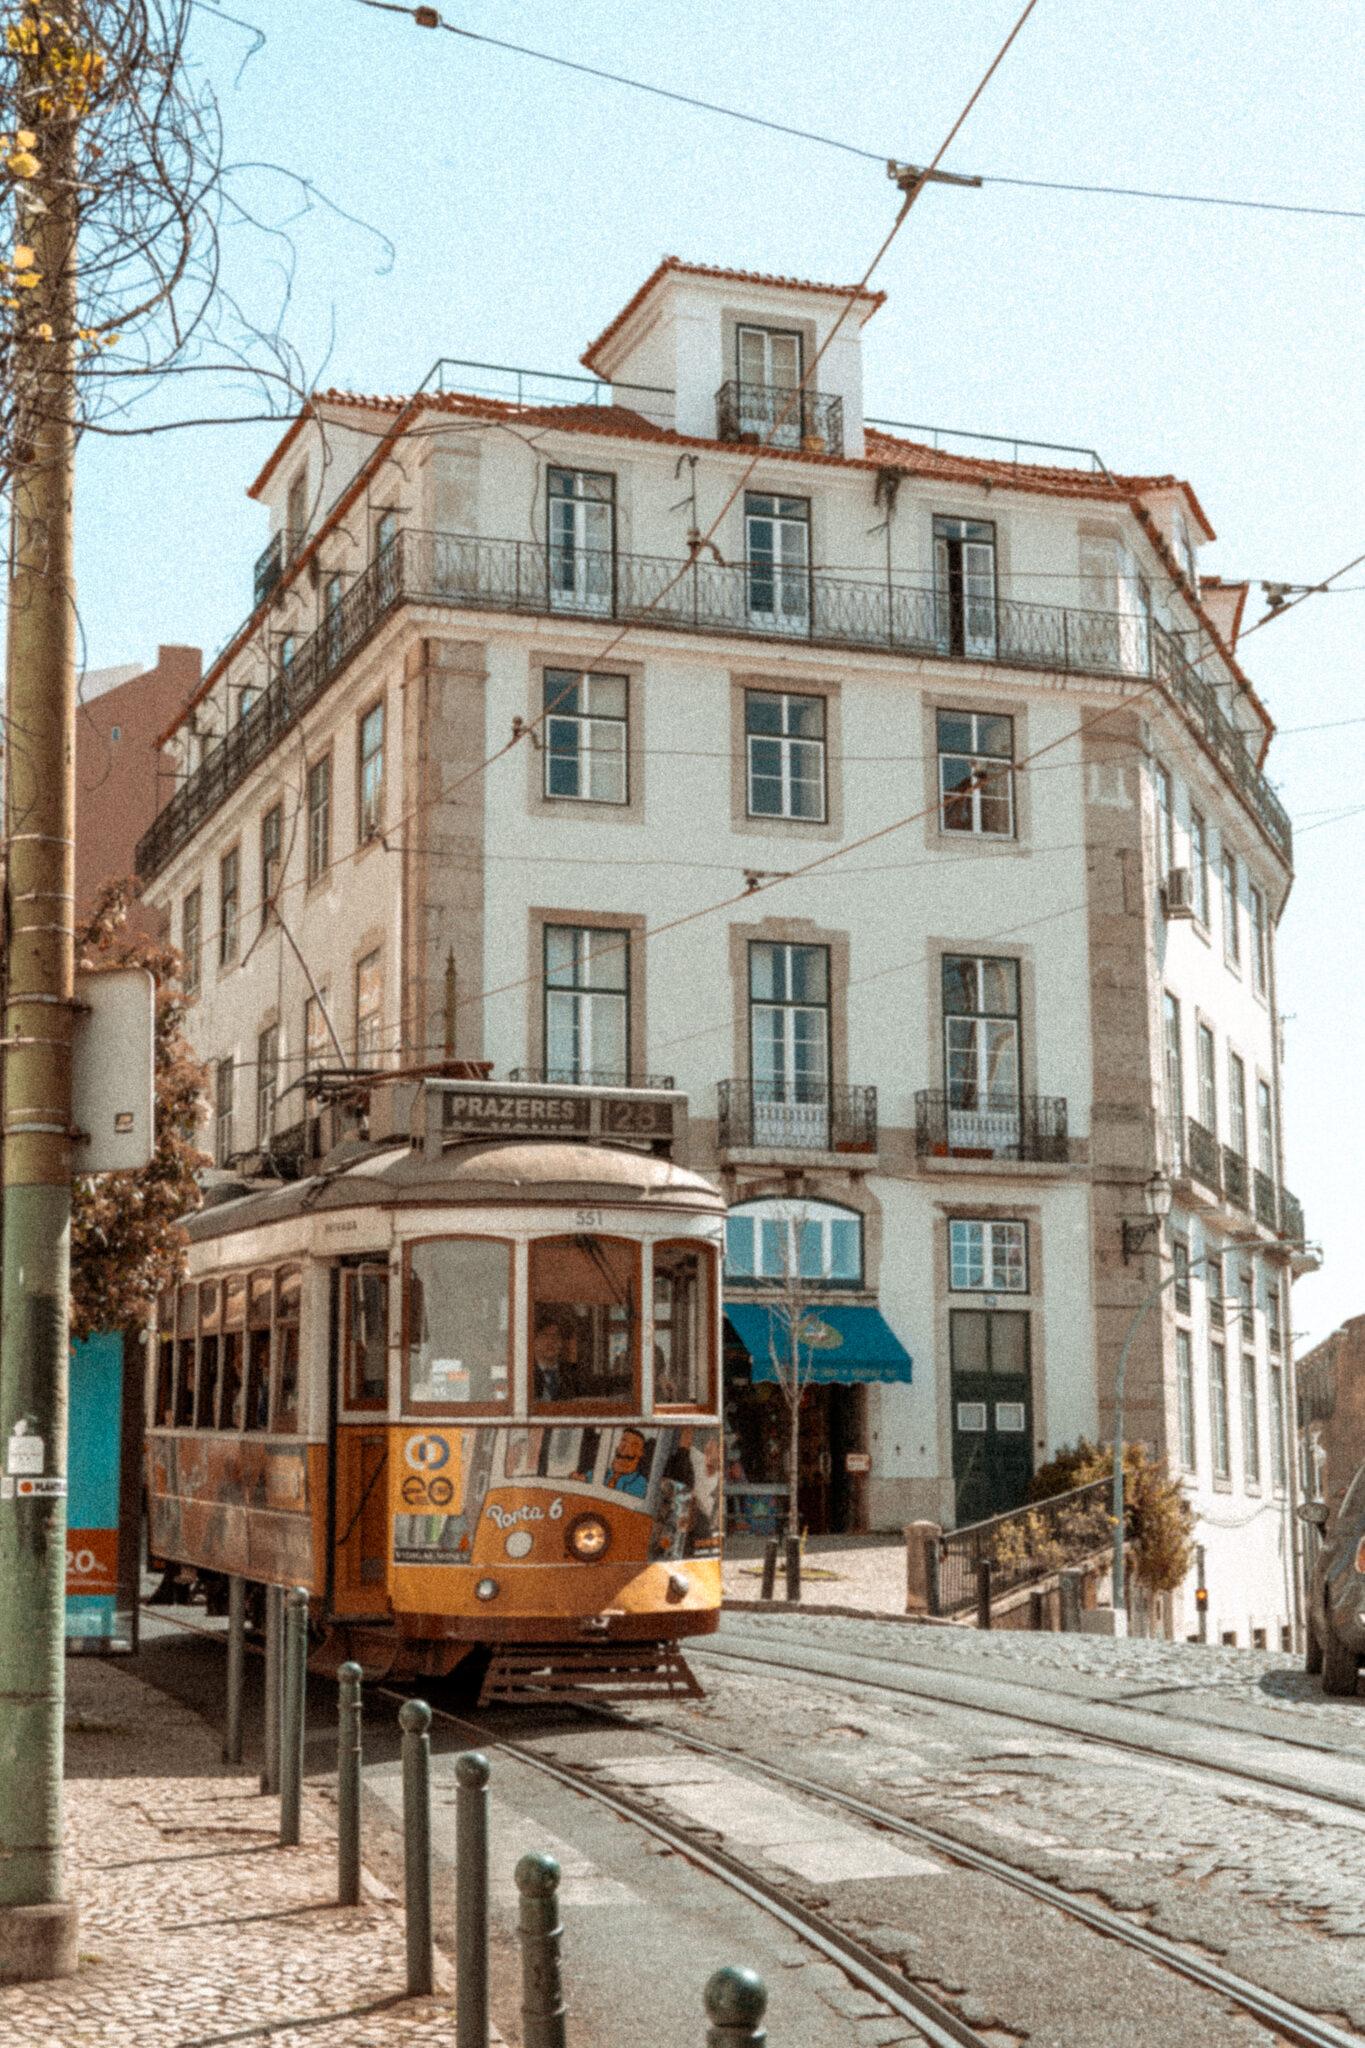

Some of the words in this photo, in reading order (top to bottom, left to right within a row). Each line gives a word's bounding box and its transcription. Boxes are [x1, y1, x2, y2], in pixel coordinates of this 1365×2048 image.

[451, 1096, 576, 1120] PRAZERES
[575, 1210, 603, 1225] 551
[487, 1504, 545, 1529] Porta
[549, 1498, 562, 1519] 6
